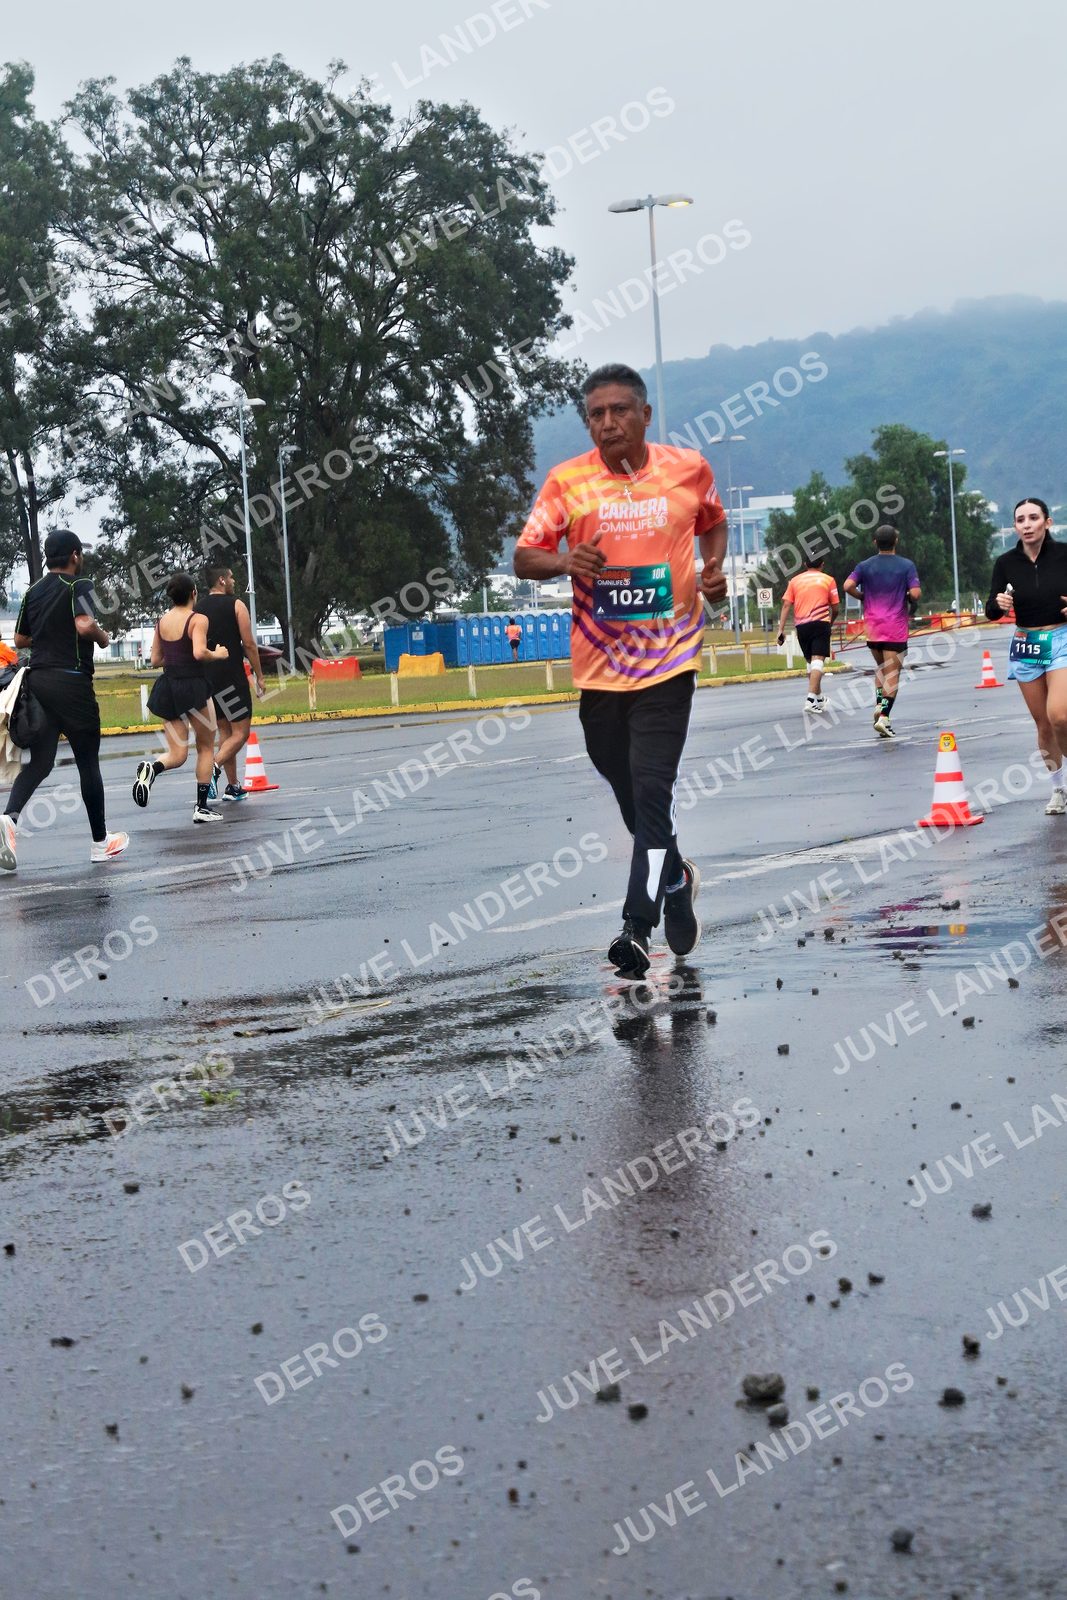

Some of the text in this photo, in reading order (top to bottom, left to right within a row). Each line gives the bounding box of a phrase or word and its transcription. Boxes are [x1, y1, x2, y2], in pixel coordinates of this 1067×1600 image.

[598, 496, 668, 519] CARRERA
[600, 516, 654, 533] OMNILIFE
[652, 567, 666, 579] 10K
[609, 588, 656, 605] 1027
[1015, 642, 1041, 655] 1115
